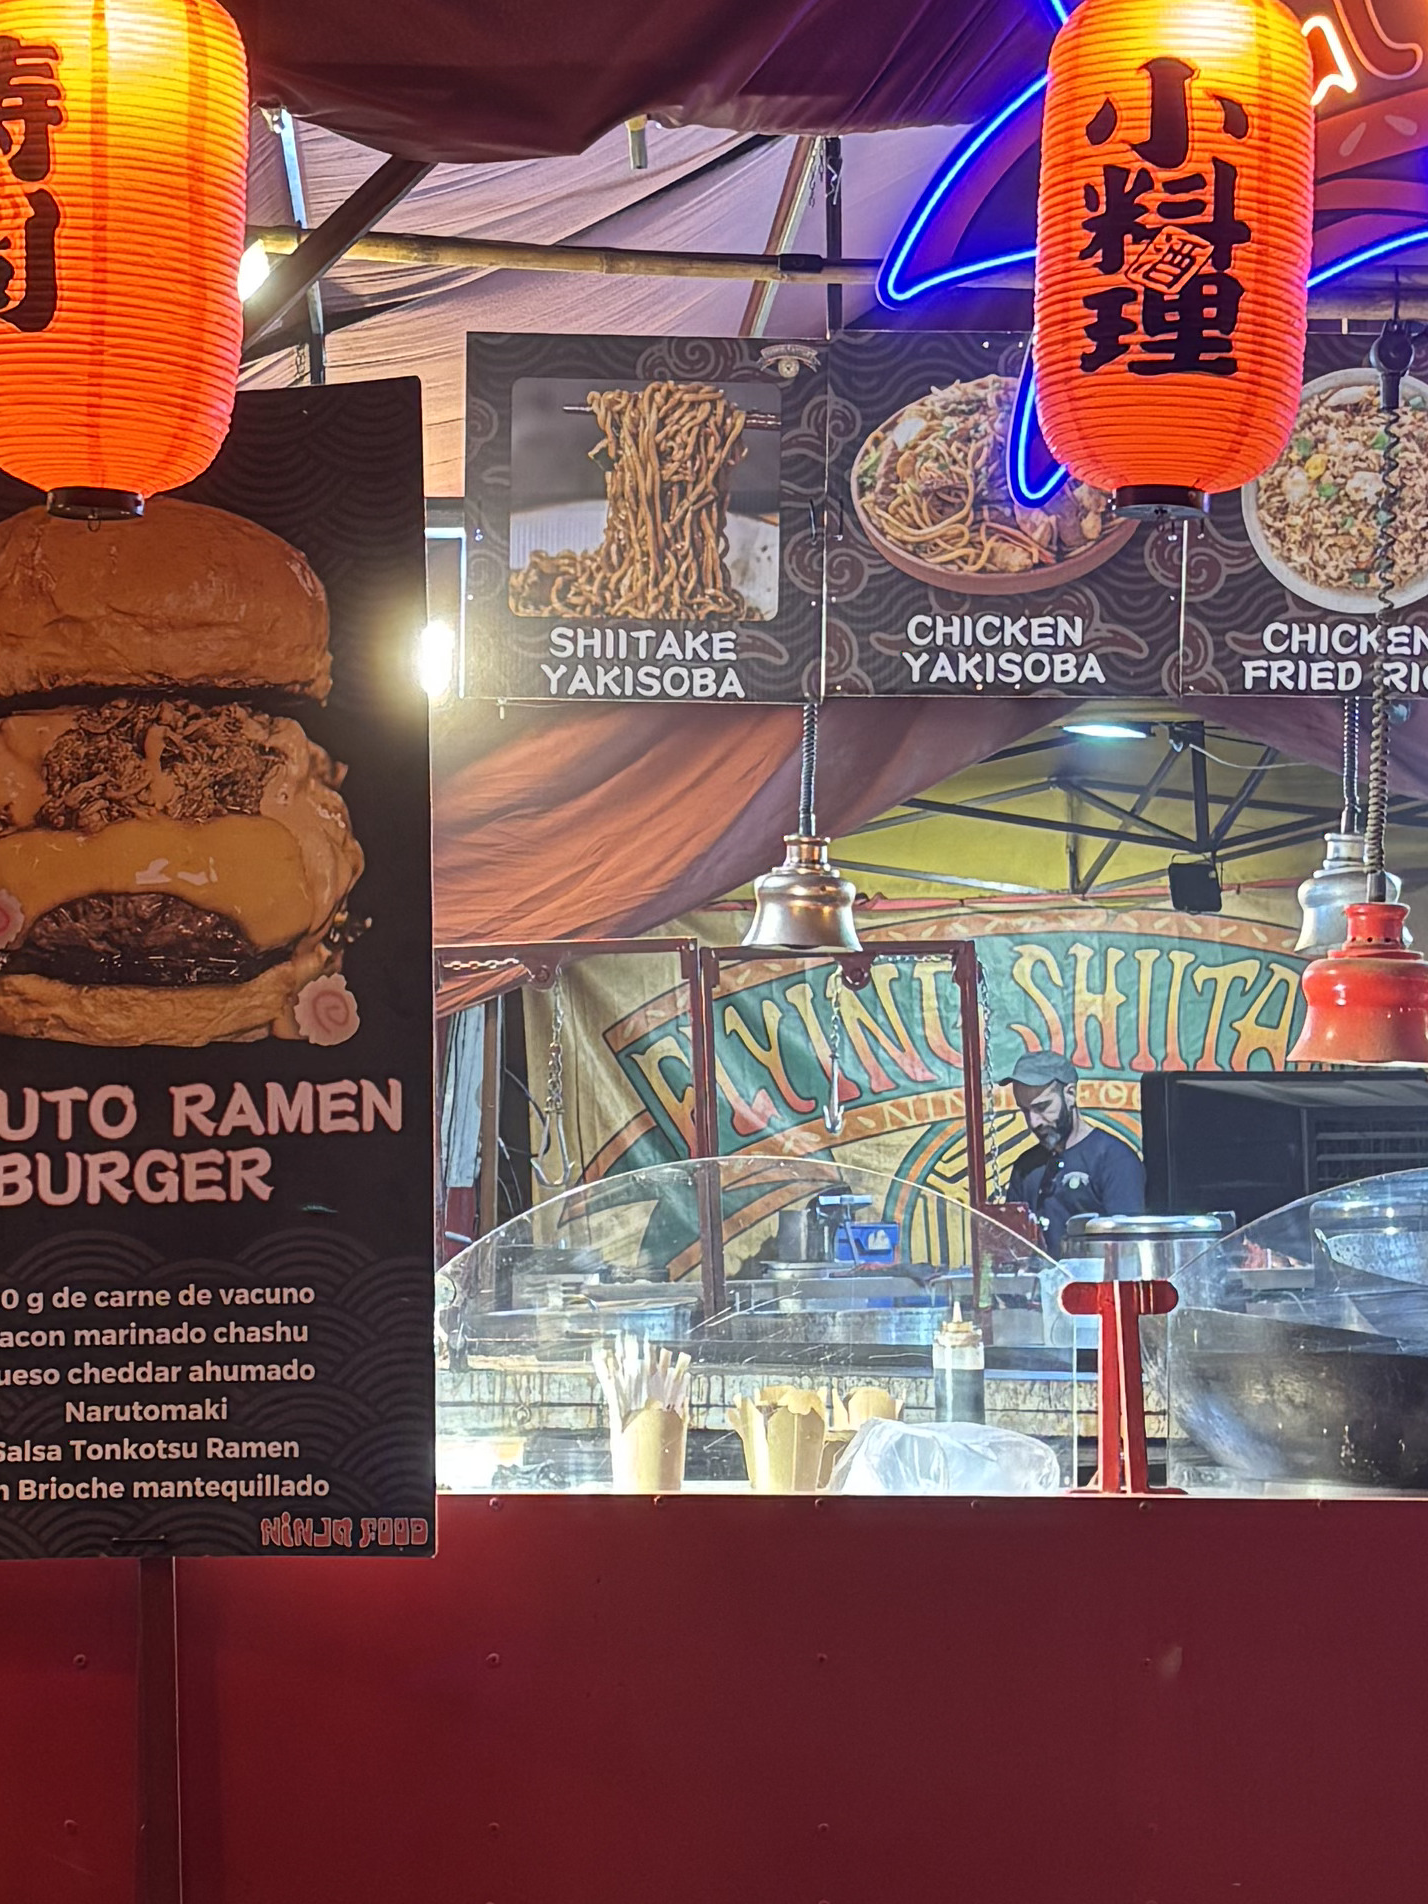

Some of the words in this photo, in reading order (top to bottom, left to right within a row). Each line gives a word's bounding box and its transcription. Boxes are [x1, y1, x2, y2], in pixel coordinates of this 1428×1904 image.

[1077, 57, 1251, 377] 小料理
[549, 626, 738, 661] SHIITAKE
[908, 614, 1083, 647] CHICKEN
[540, 663, 746, 699] YAKISOBA
[902, 651, 1106, 686] YAKISOBA
[1242, 659, 1363, 692] FRIED
[1008, 942, 1307, 1073] SHIITA
[169, 1077, 403, 1137] RAMEN
[28, 1293, 44, 1314] g
[52, 1287, 87, 1308] de
[94, 1289, 171, 1308] carne
[178, 1283, 212, 1306] de
[219, 1287, 315, 1305] vacuno
[74, 1322, 207, 1346] marinado
[213, 1320, 308, 1343] chashu
[67, 1360, 182, 1384] cheddar
[188, 1358, 316, 1382] ahumado
[65, 1396, 228, 1423] Narutomaki
[69, 1437, 198, 1461] Tonkotsu
[207, 1437, 299, 1459] Ramen
[18, 1476, 125, 1500] Brioche
[133, 1473, 330, 1502] mantequillado
[359, 1516, 429, 1549] FOOD
